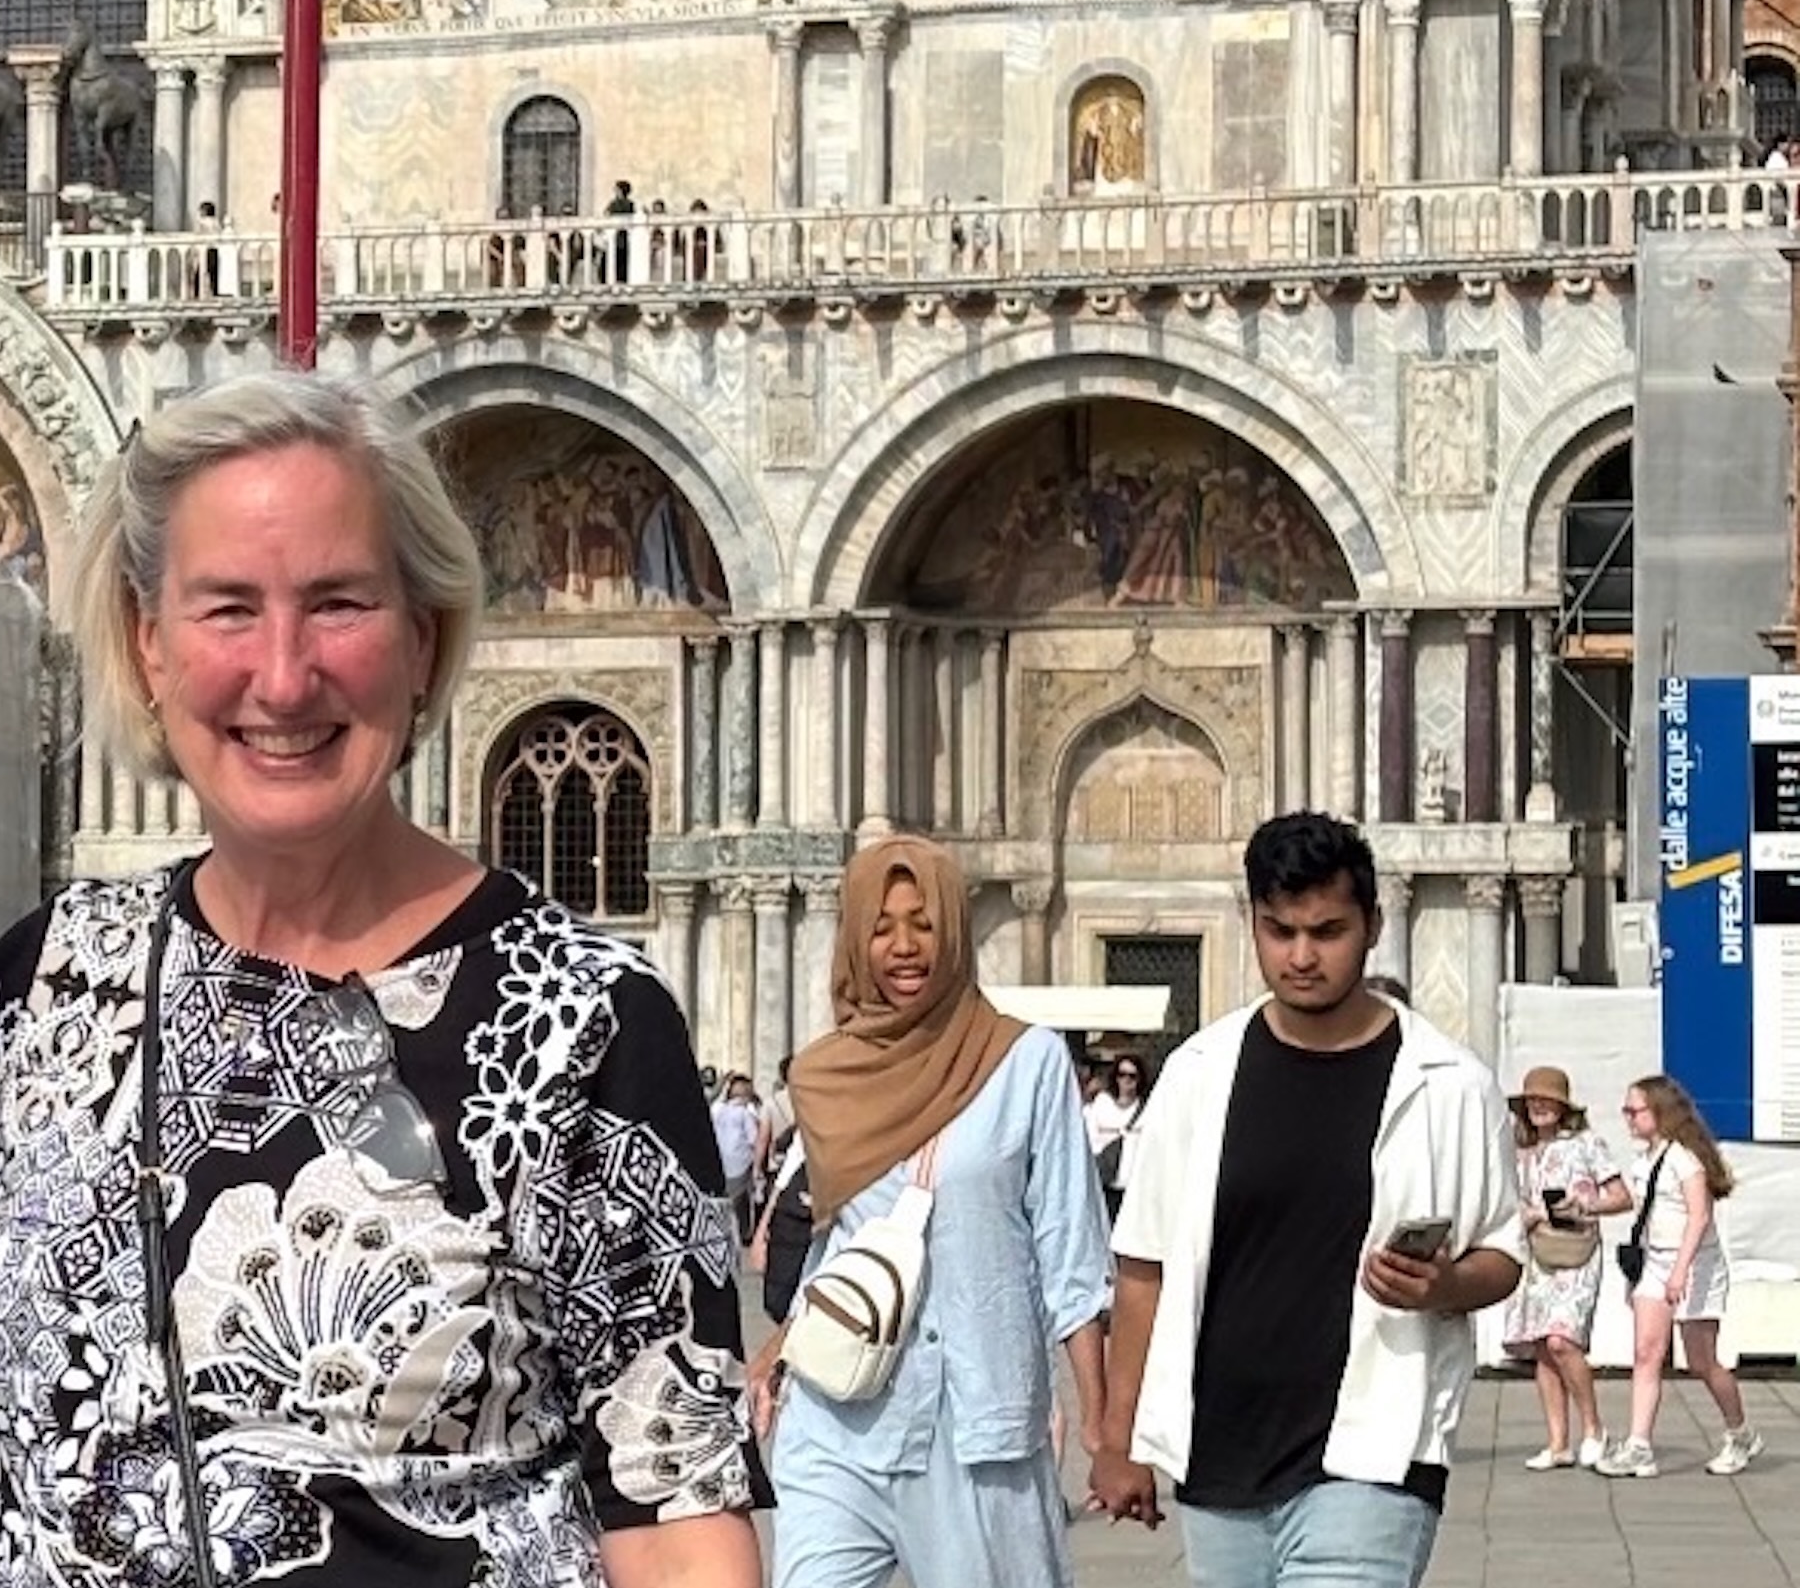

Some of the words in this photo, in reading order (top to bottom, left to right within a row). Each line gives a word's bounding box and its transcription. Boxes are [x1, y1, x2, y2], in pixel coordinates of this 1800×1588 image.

[1658, 676, 1688, 725] alte
[1666, 729, 1695, 807] acque
[1659, 809, 1688, 872] dalle
[1718, 870, 1744, 965] DIFESA
